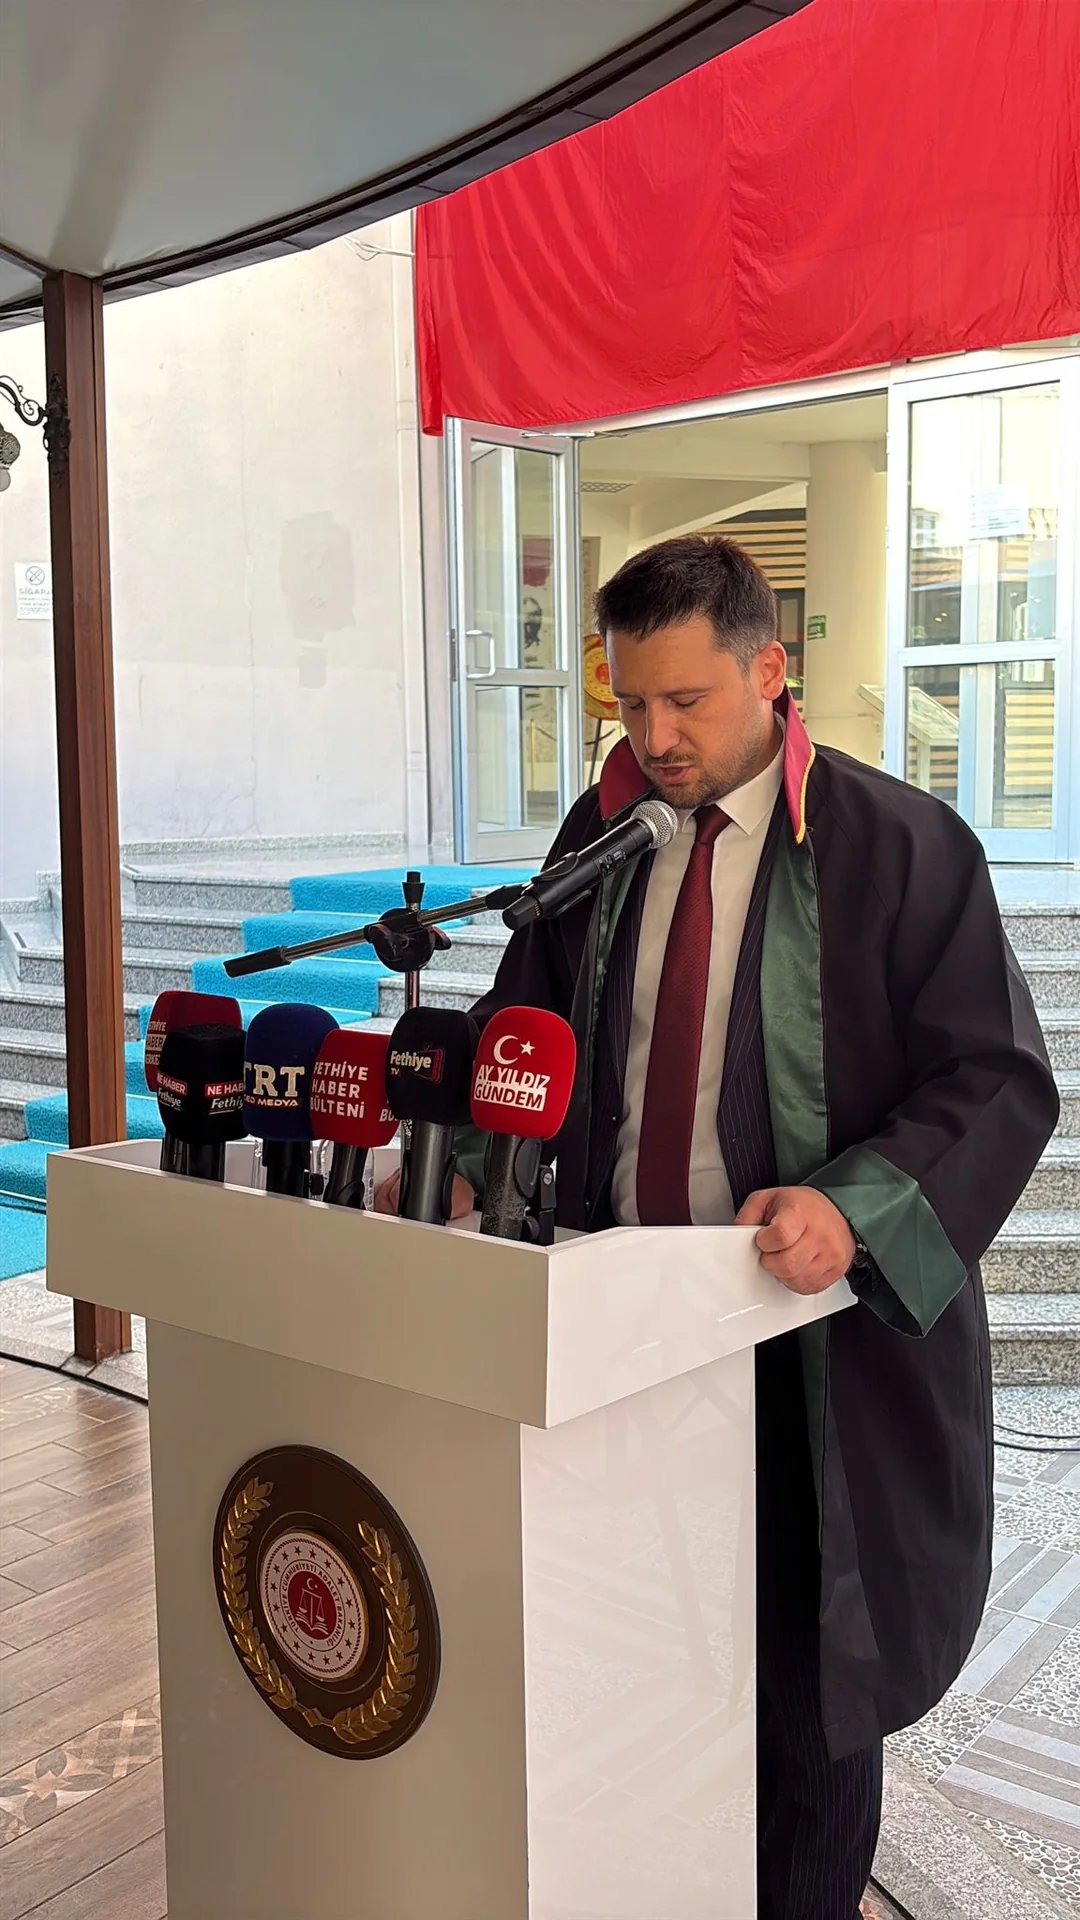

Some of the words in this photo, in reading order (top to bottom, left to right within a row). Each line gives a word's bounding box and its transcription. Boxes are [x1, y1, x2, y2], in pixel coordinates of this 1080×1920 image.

[146, 1035, 164, 1048] ABER
[313, 1061, 369, 1081] FETHİYE
[390, 1050, 432, 1072] Fethiye
[390, 1067, 400, 1075] TV
[163, 1077, 186, 1095] HABER
[476, 1064, 495, 1082] AY
[497, 1066, 551, 1089] YILDIZ
[158, 1087, 182, 1108] Fethiye
[207, 1085, 222, 1096] NE
[224, 1082, 244, 1094] HAB
[311, 1078, 361, 1099] HABER
[475, 1082, 543, 1109] GÜNDEM
[211, 1096, 244, 1110] Fethiy
[257, 1098, 299, 1107] MEDYA
[309, 1095, 365, 1119] BÜLTENİ
[318, 1571, 340, 1602] ADALET
